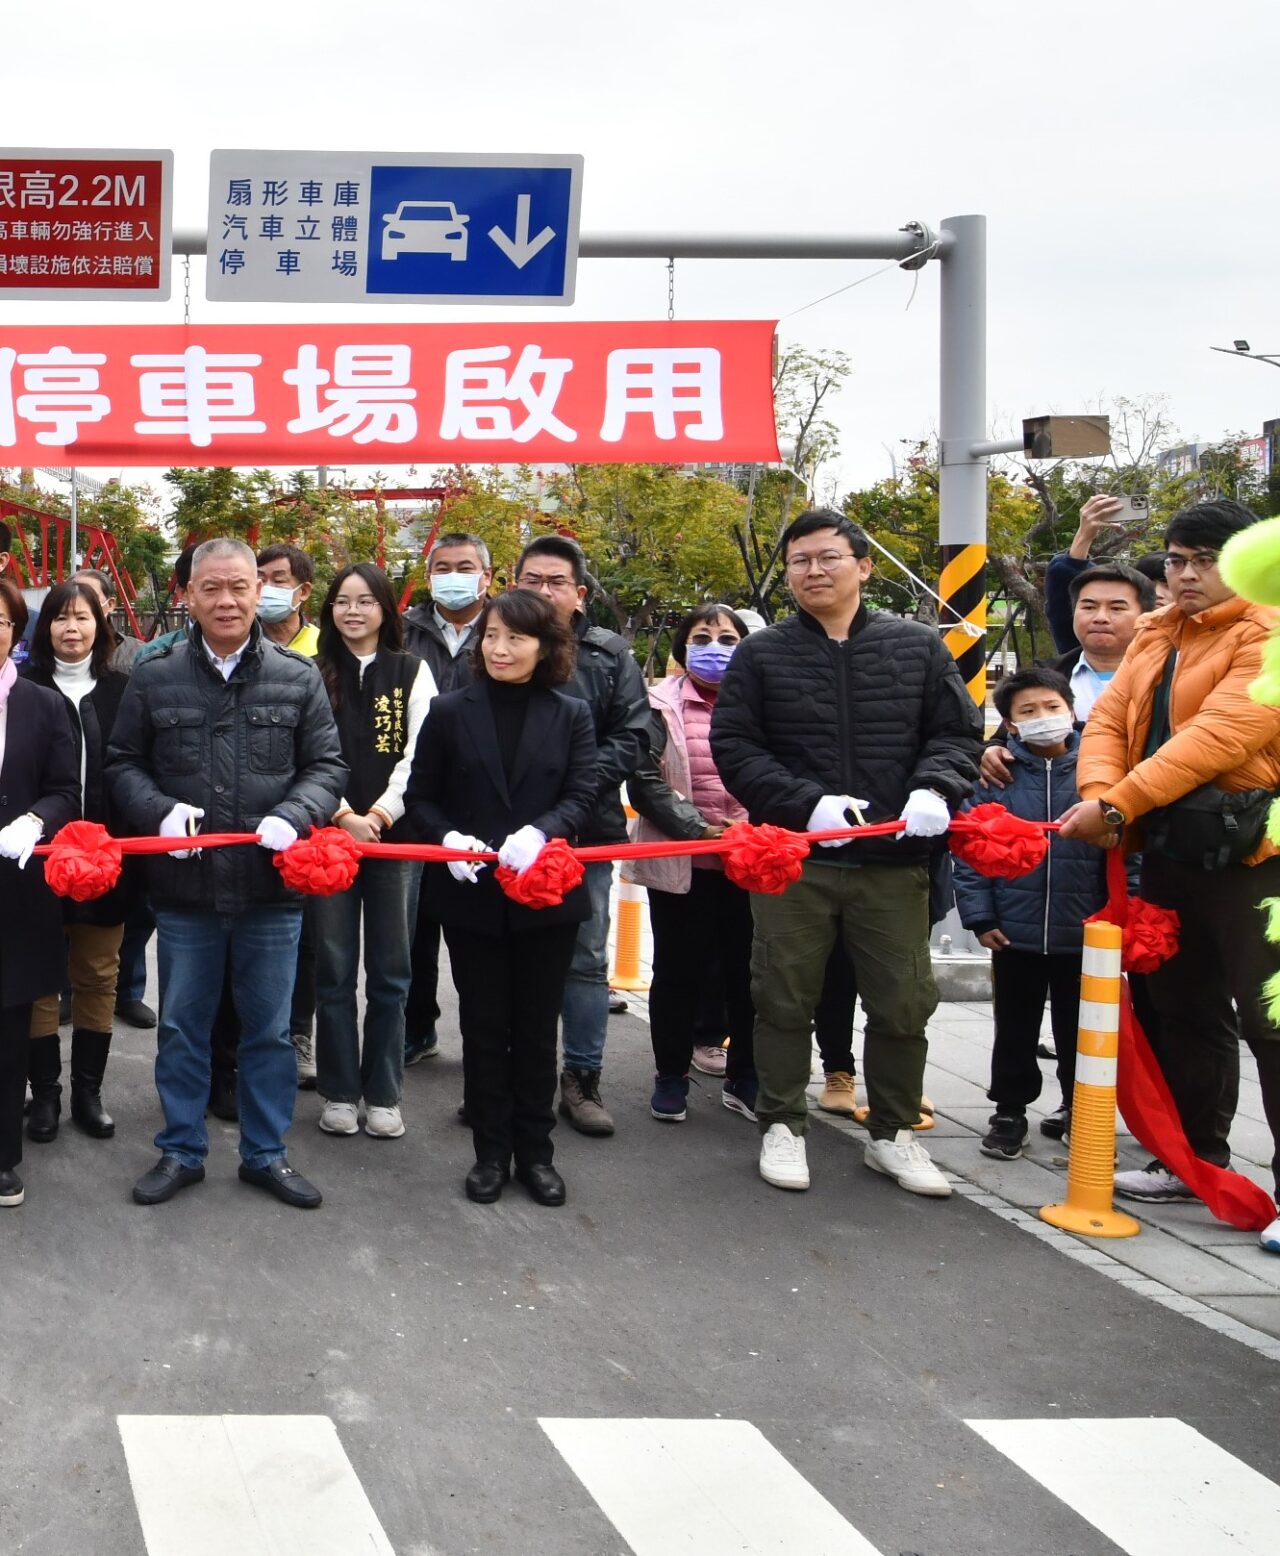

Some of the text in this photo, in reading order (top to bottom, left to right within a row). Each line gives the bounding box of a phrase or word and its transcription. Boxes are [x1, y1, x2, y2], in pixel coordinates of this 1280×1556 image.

[226, 179, 361, 207] 扇形車庫
[222, 214, 358, 242] 汽車立體
[219, 249, 358, 277] 停車場
[374, 695, 392, 753] 凌巧芸
